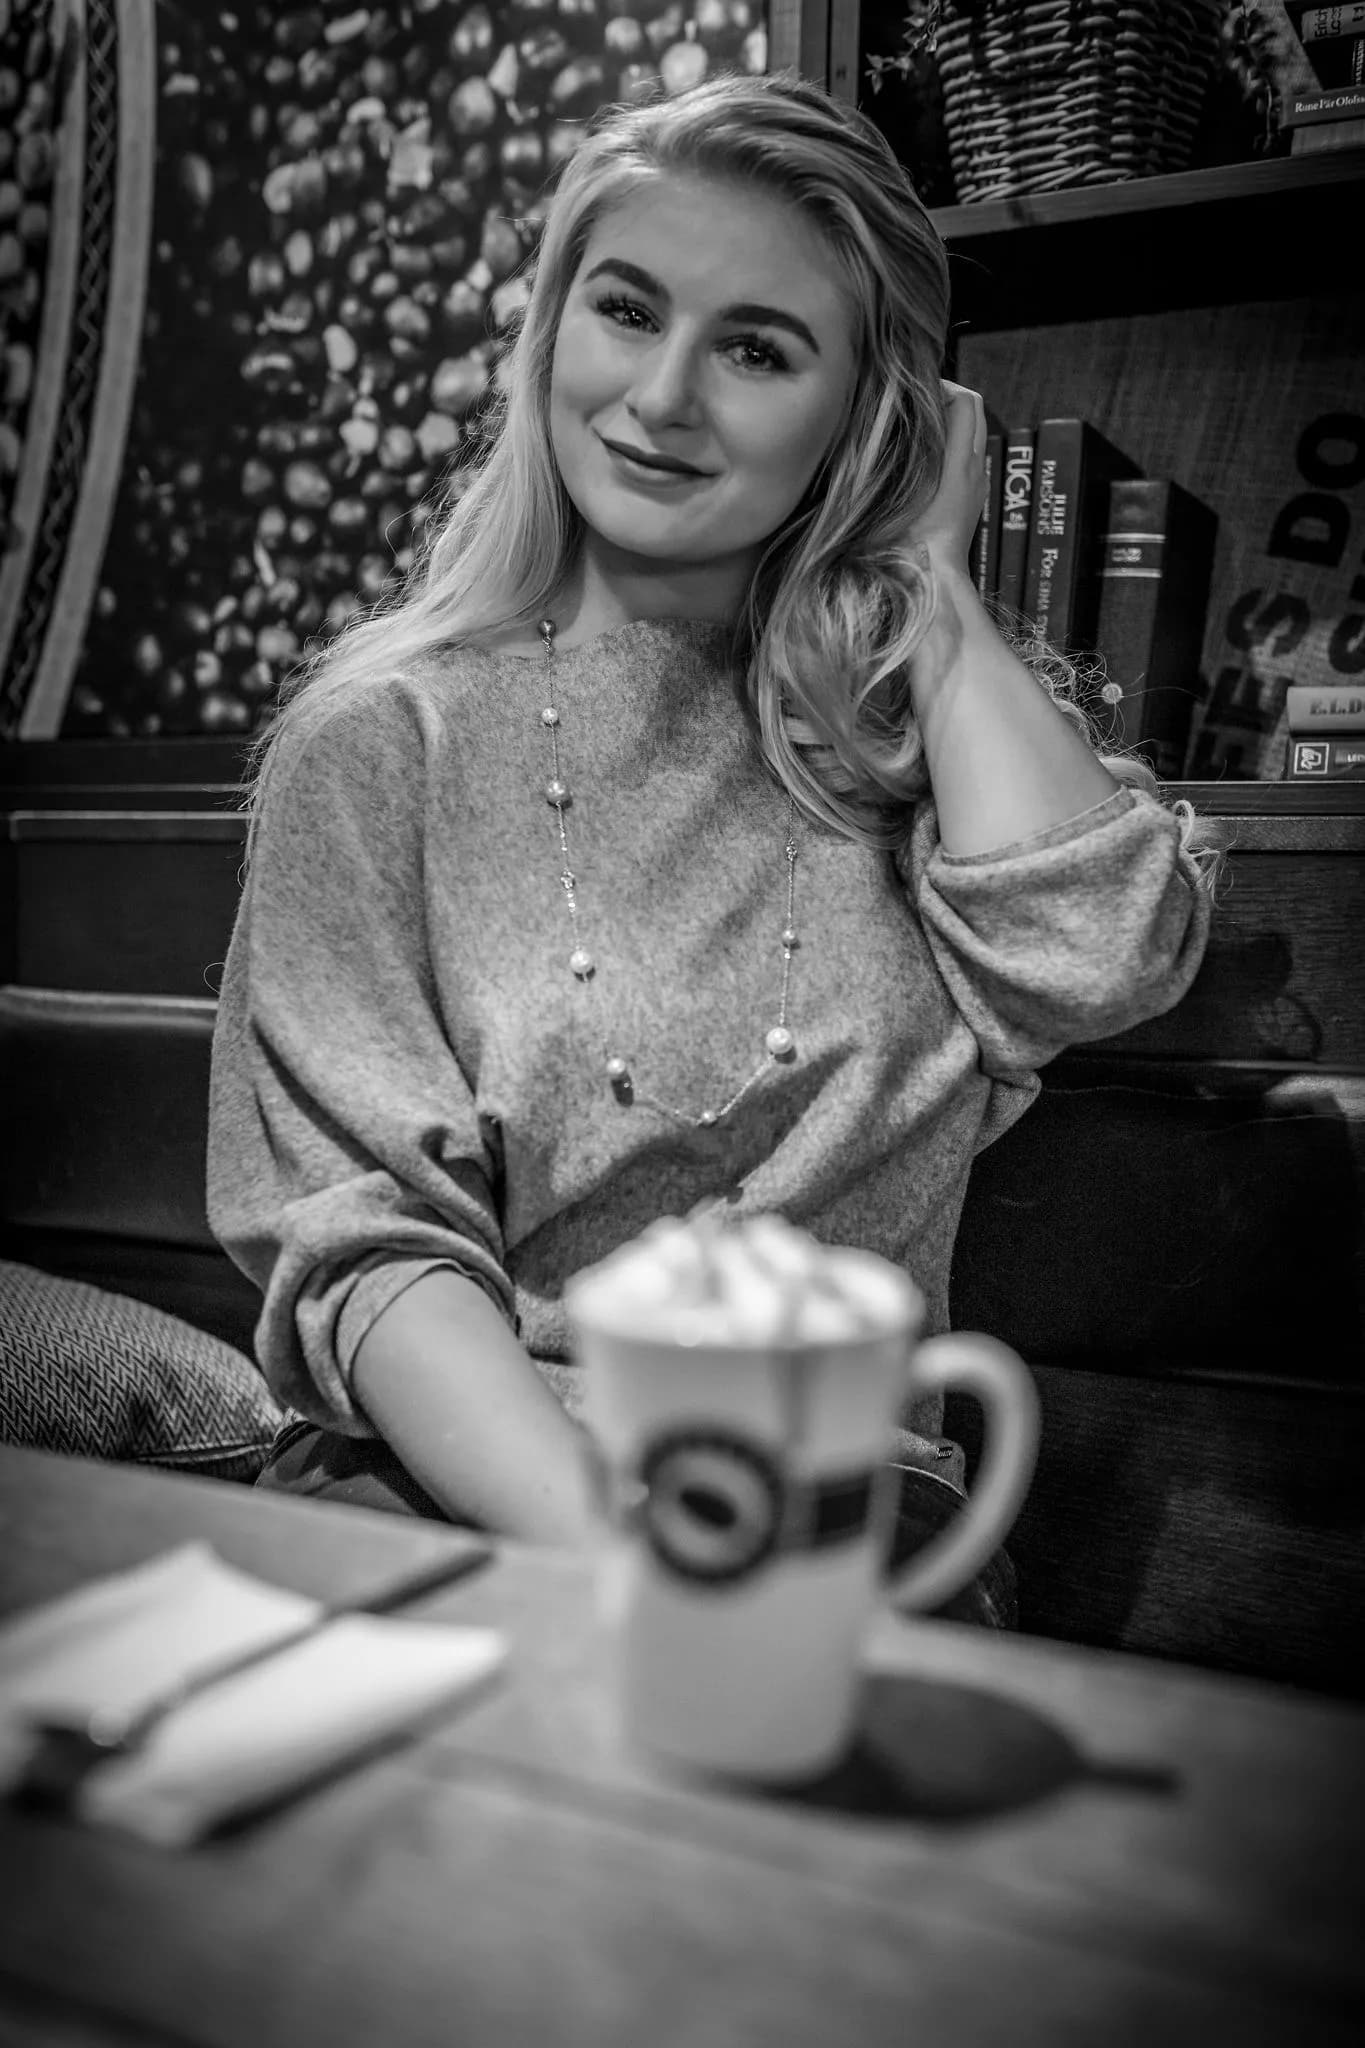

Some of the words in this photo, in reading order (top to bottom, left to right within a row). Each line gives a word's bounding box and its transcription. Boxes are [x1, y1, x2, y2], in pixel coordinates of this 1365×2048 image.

[1295, 102, 1319, 113] Rune
[1003, 446, 1034, 512] FUGA
[1037, 459, 1057, 535] PARSONS
[1267, 413, 1365, 568] DO
[1051, 494, 1067, 536] JULIE
